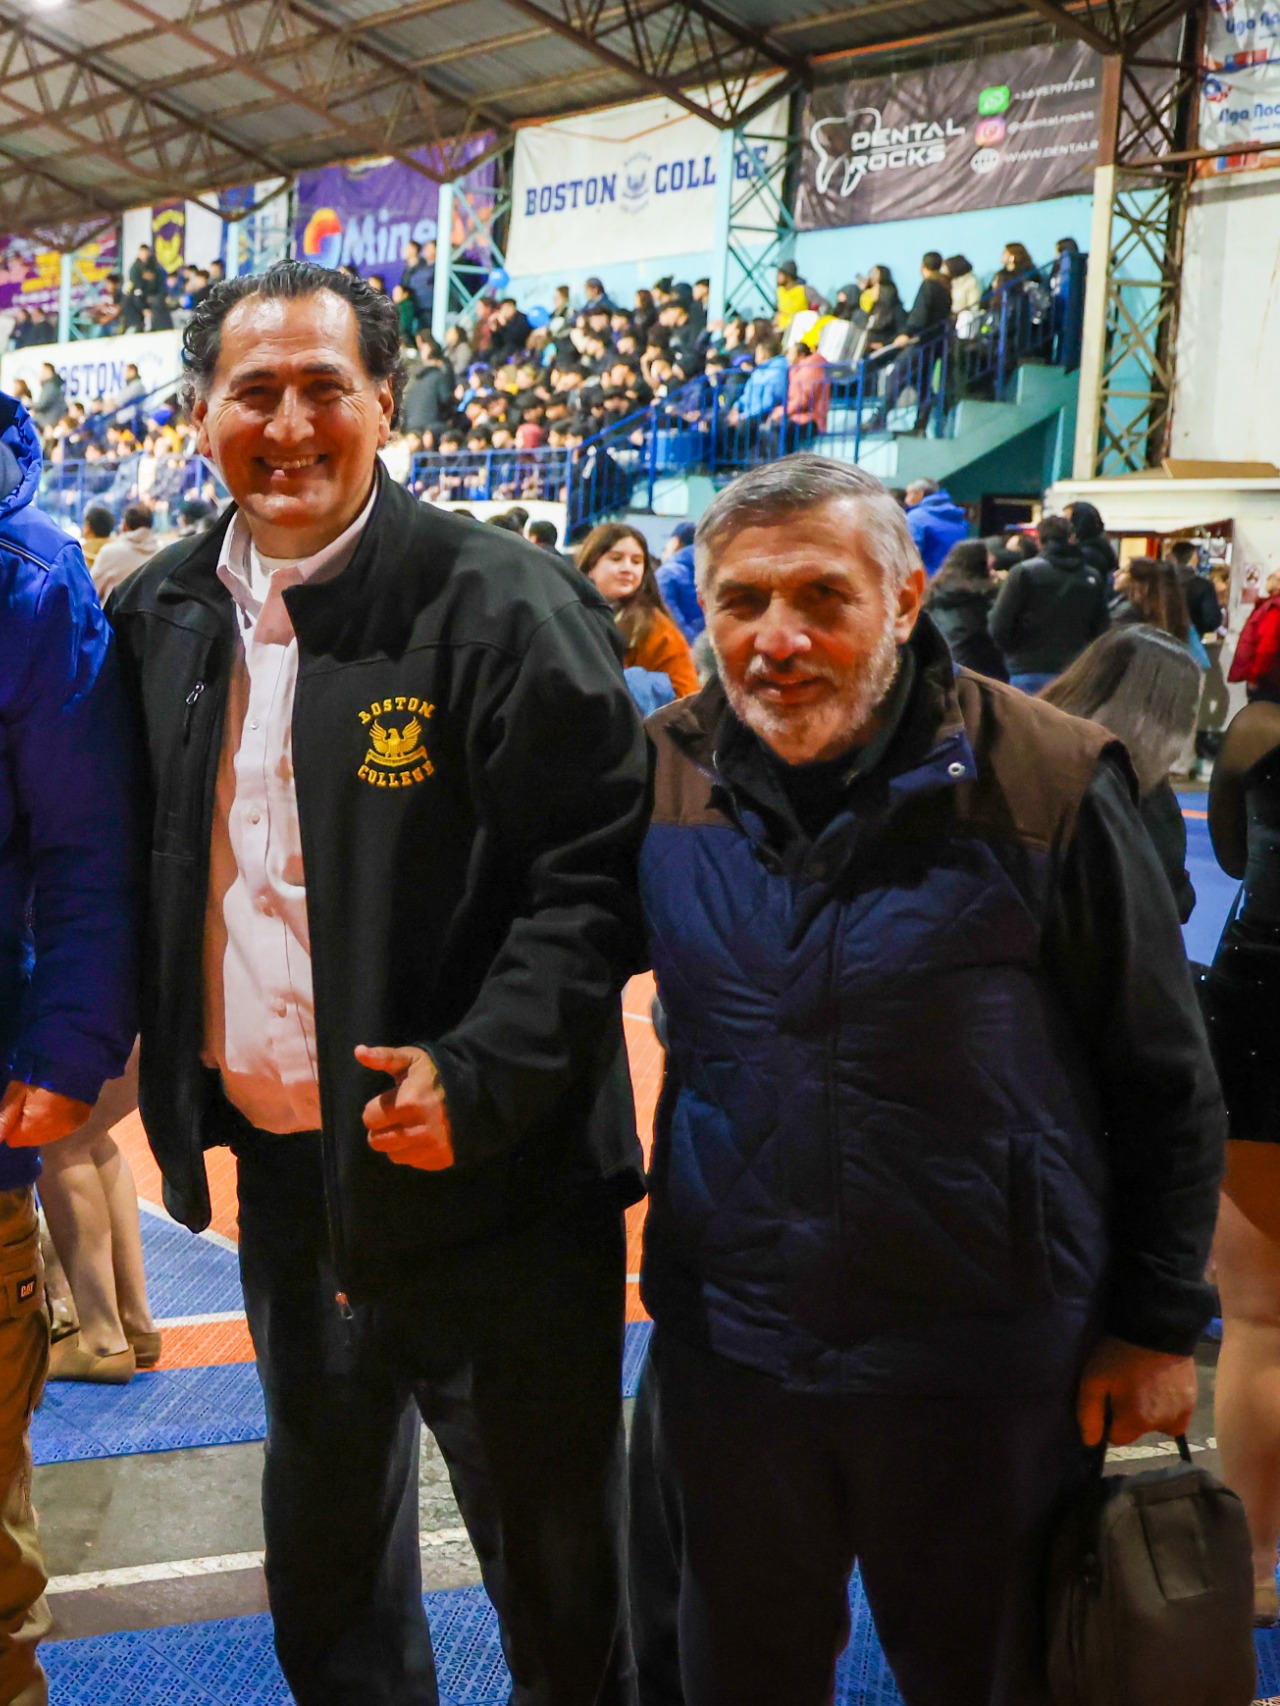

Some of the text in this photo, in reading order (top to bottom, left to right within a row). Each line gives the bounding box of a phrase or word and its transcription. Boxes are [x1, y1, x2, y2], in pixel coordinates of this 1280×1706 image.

[851, 118, 965, 151] DENTAL
[849, 144, 946, 176] ROCKS
[524, 145, 768, 215] BOSTON COLLGE
[358, 697, 435, 725] BOSTON
[358, 760, 434, 788] COLLEGE
[21, 1281, 34, 1298] CAT
